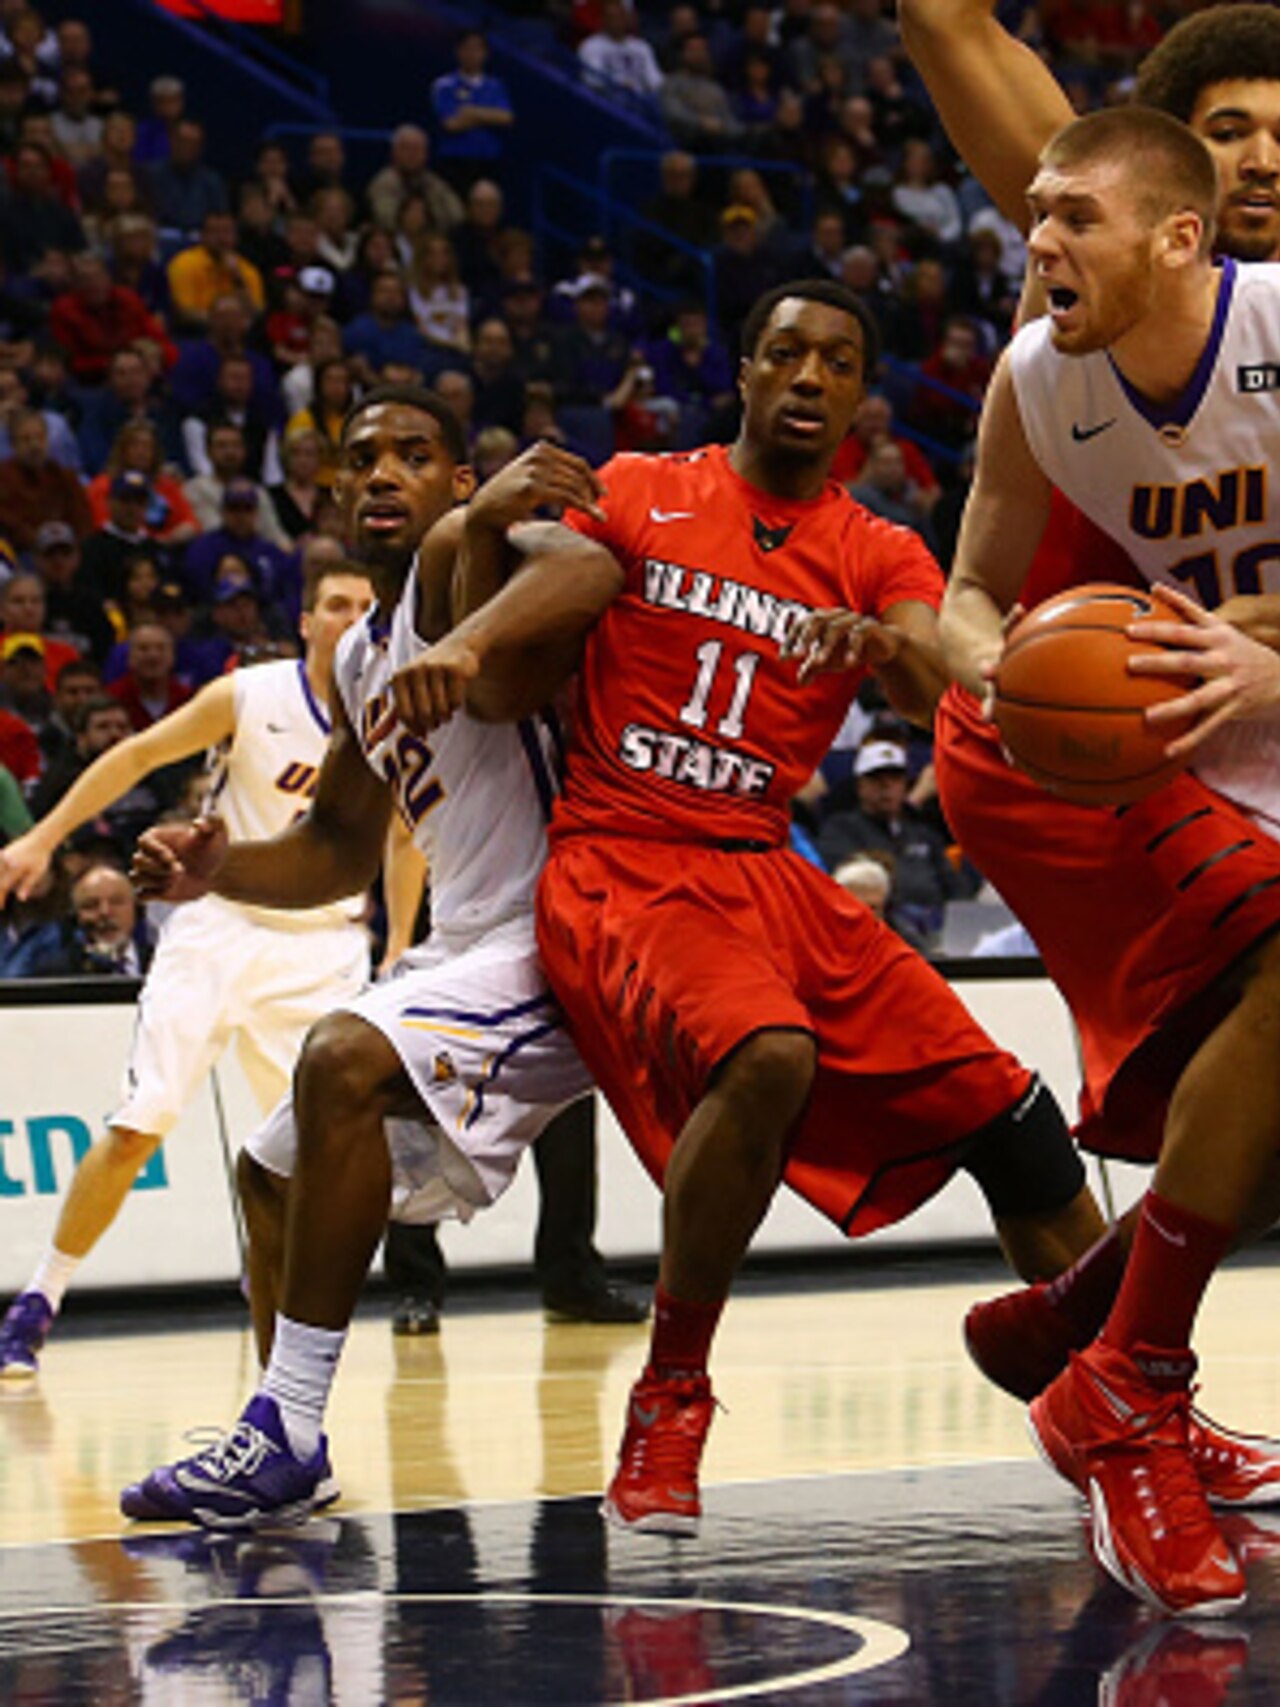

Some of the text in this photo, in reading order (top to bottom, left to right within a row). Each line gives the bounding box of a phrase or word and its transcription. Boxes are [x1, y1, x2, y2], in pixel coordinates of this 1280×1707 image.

[1129, 463, 1268, 542] UNI
[679, 638, 760, 740] 11
[619, 725, 775, 796] STATE
